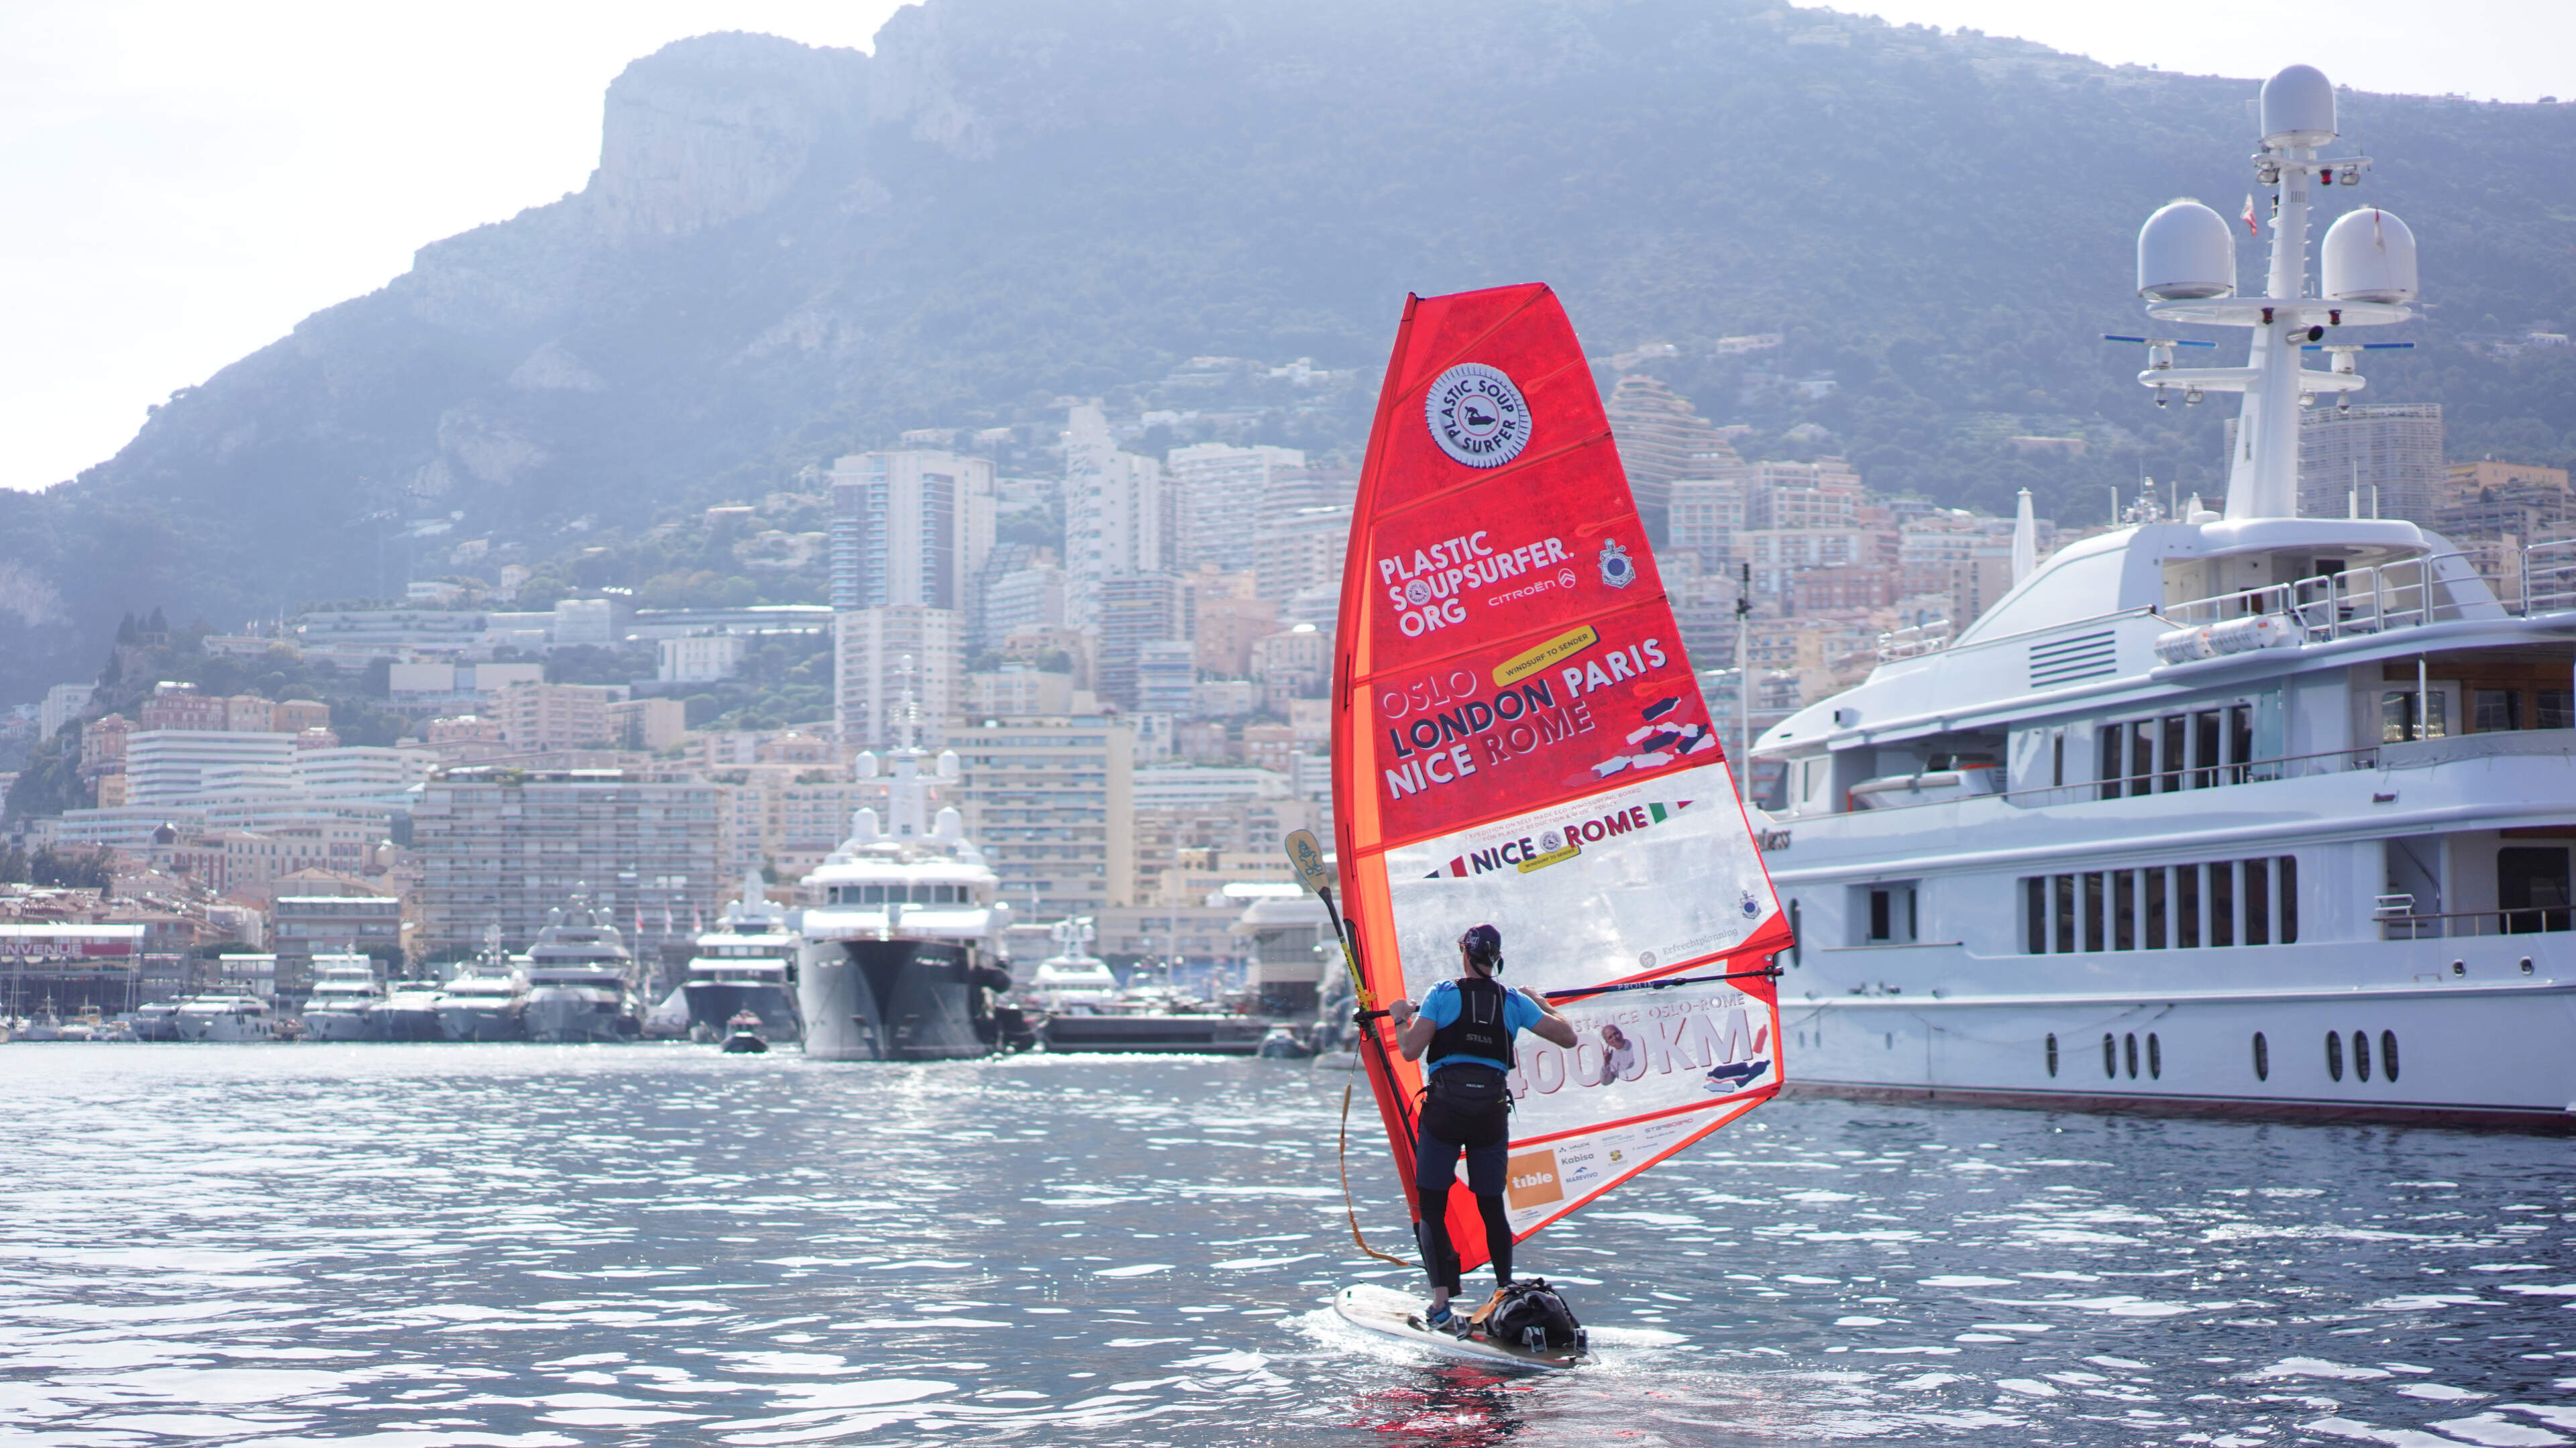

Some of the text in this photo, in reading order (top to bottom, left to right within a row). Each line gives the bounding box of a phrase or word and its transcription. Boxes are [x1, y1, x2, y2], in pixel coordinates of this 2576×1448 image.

[1441, 380, 1516, 453] PLASTIC SOUP SURFER
[1379, 531, 1493, 585] PLASTIC
[1399, 598, 1468, 637] ORG
[1505, 634, 1589, 676] WINDSURF TO SENDER
[1383, 668, 1477, 719] OSLO
[1389, 638, 1667, 759] LONDON PARIS
[1385, 700, 1595, 799] NICE ROME
[1464, 826, 1504, 840] EXPEDITION
[1534, 812, 1552, 820] MADE
[1618, 787, 1642, 798] BOARD
[1497, 826, 1525, 837] PLASTIC
[1526, 816, 1564, 830] REDUCTION
[1594, 801, 1617, 811] POLICY
[1470, 837, 1537, 874] NICE
[1564, 805, 1648, 848] ROME
[1663, 928, 1739, 955] Erfrechtplanning
[1618, 982, 1654, 991] PROLIM
[1570, 993, 1746, 1033] STANCE OSLO-ROME
[1466, 1034, 1493, 1044] SILVA
[1562, 1154, 1595, 1165] Kabisa
[1566, 1172, 1598, 1182] MAREVIVO
[1512, 1172, 1554, 1189] tible
